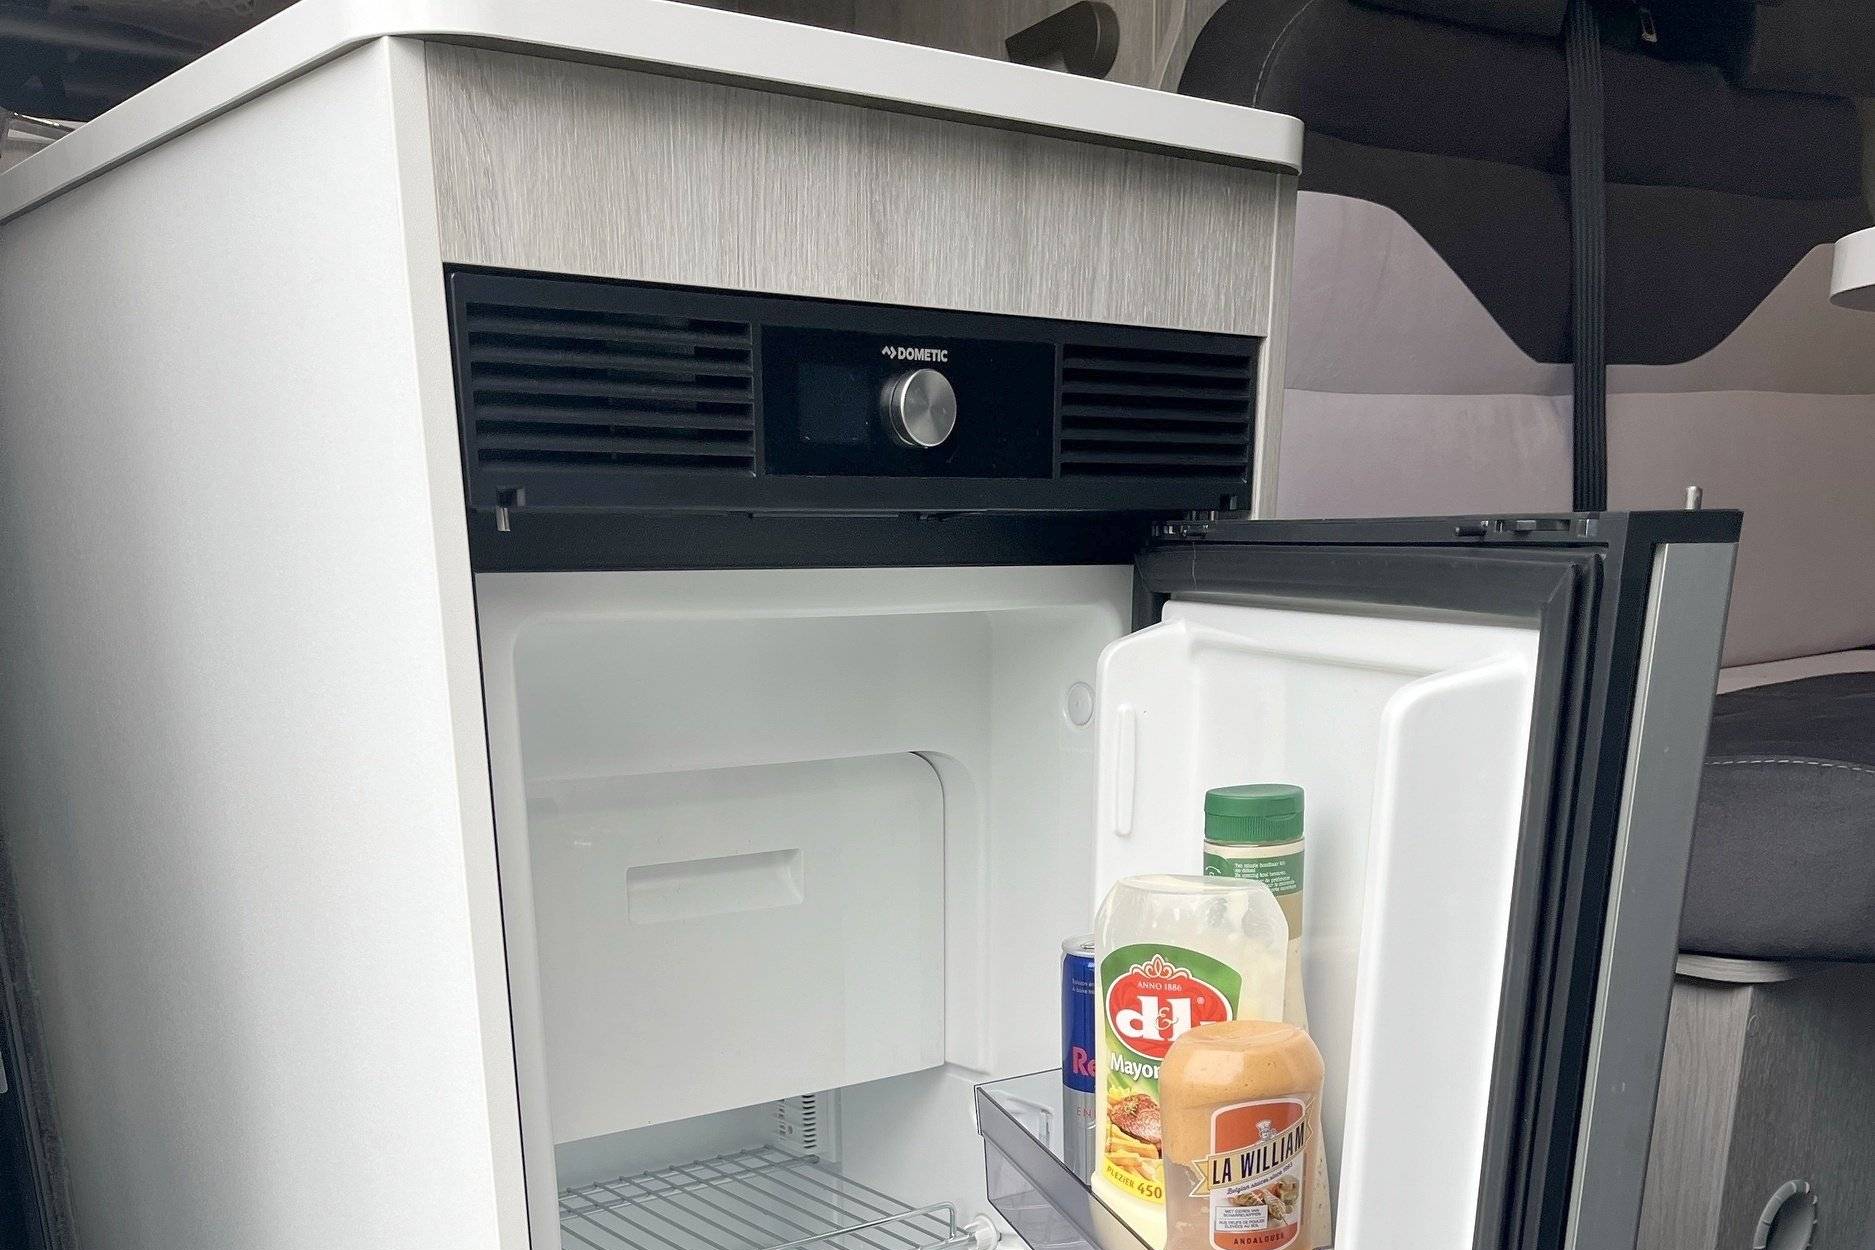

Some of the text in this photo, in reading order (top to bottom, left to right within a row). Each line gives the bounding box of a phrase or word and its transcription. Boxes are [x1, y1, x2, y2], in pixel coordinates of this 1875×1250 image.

[897, 347, 948, 362] DOMETIC
[1137, 981, 1183, 992] ANNO 1886
[1212, 1121, 1305, 1185] LA WILLIAM
[1137, 1182, 1163, 1199] 450
